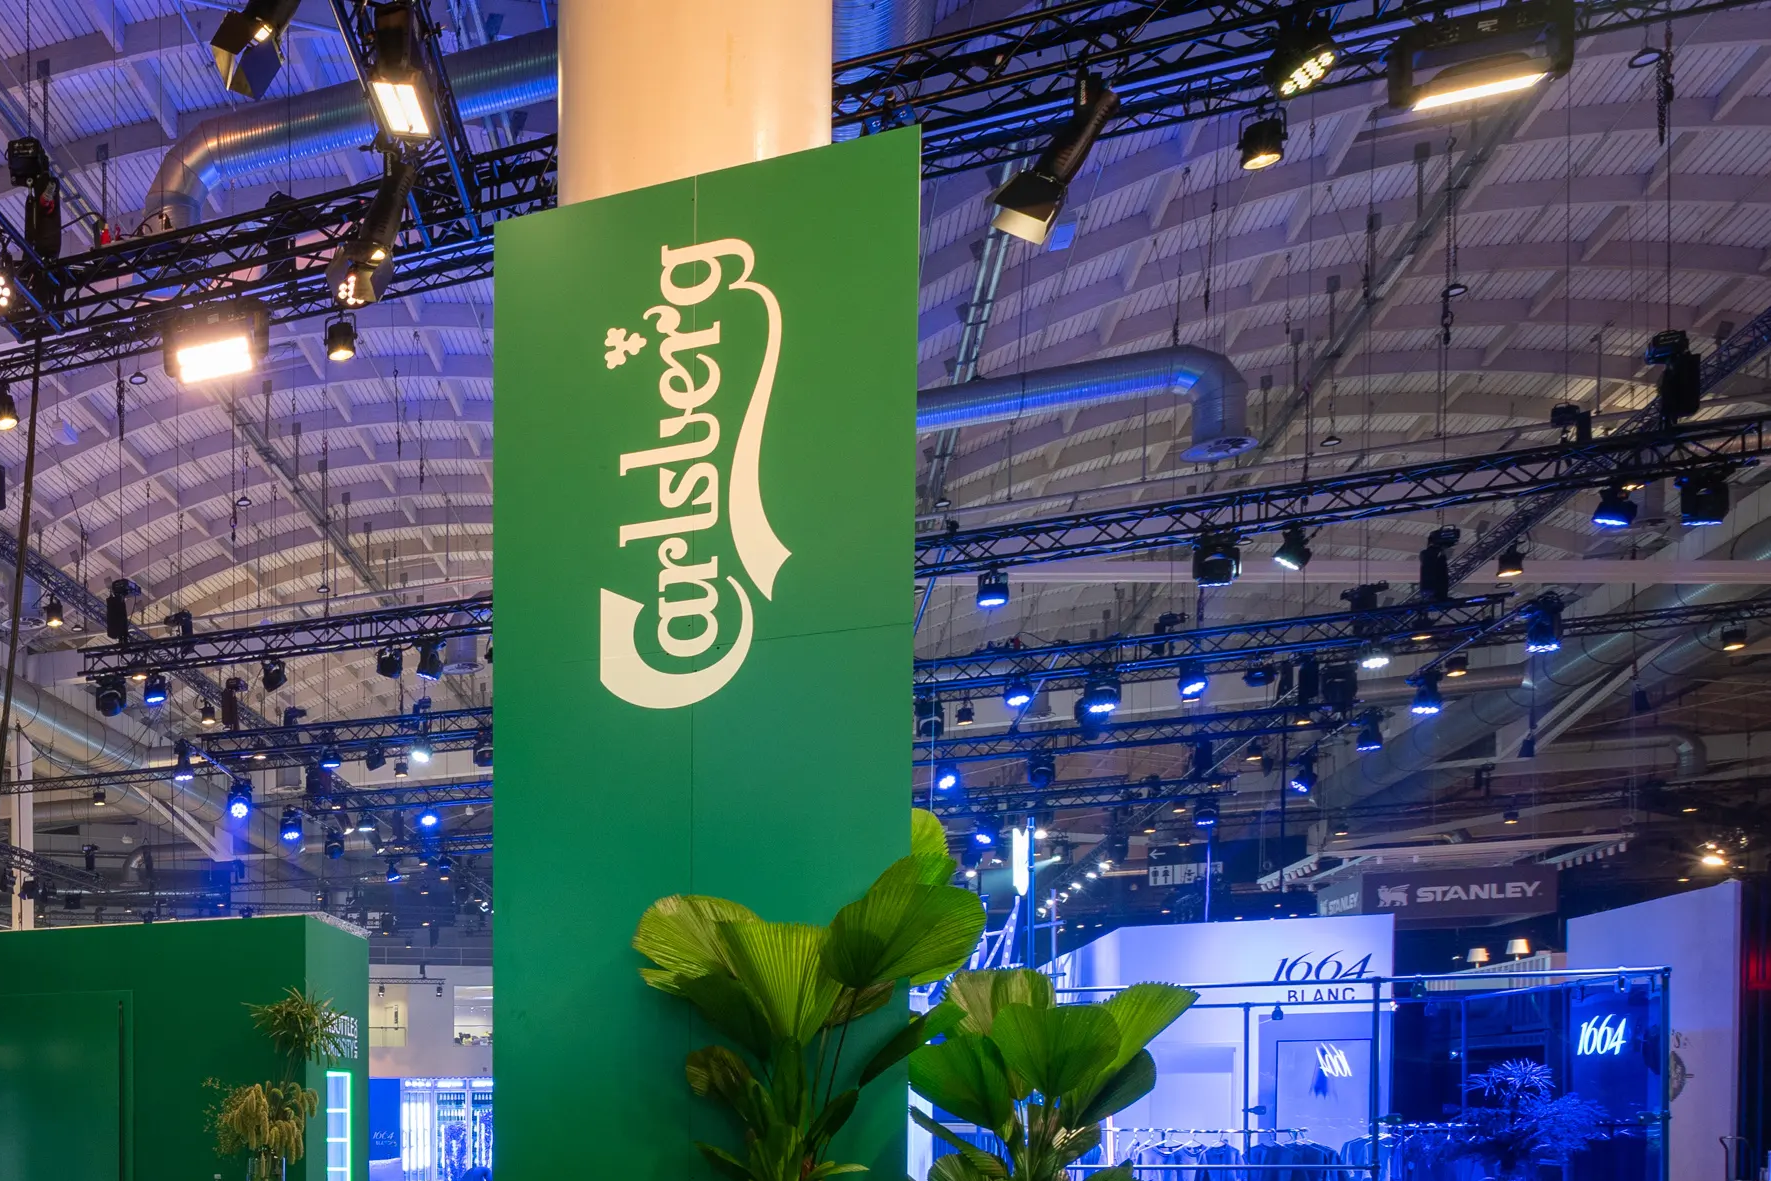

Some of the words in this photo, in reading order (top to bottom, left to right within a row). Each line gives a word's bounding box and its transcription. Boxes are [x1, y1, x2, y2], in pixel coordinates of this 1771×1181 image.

[600, 238, 758, 709] Carlsberg
[1328, 892, 1359, 914] STANLEY
[1416, 881, 1541, 903] STANLEY
[1273, 950, 1375, 981] 1664
[1577, 1014, 1627, 1056] 1664
